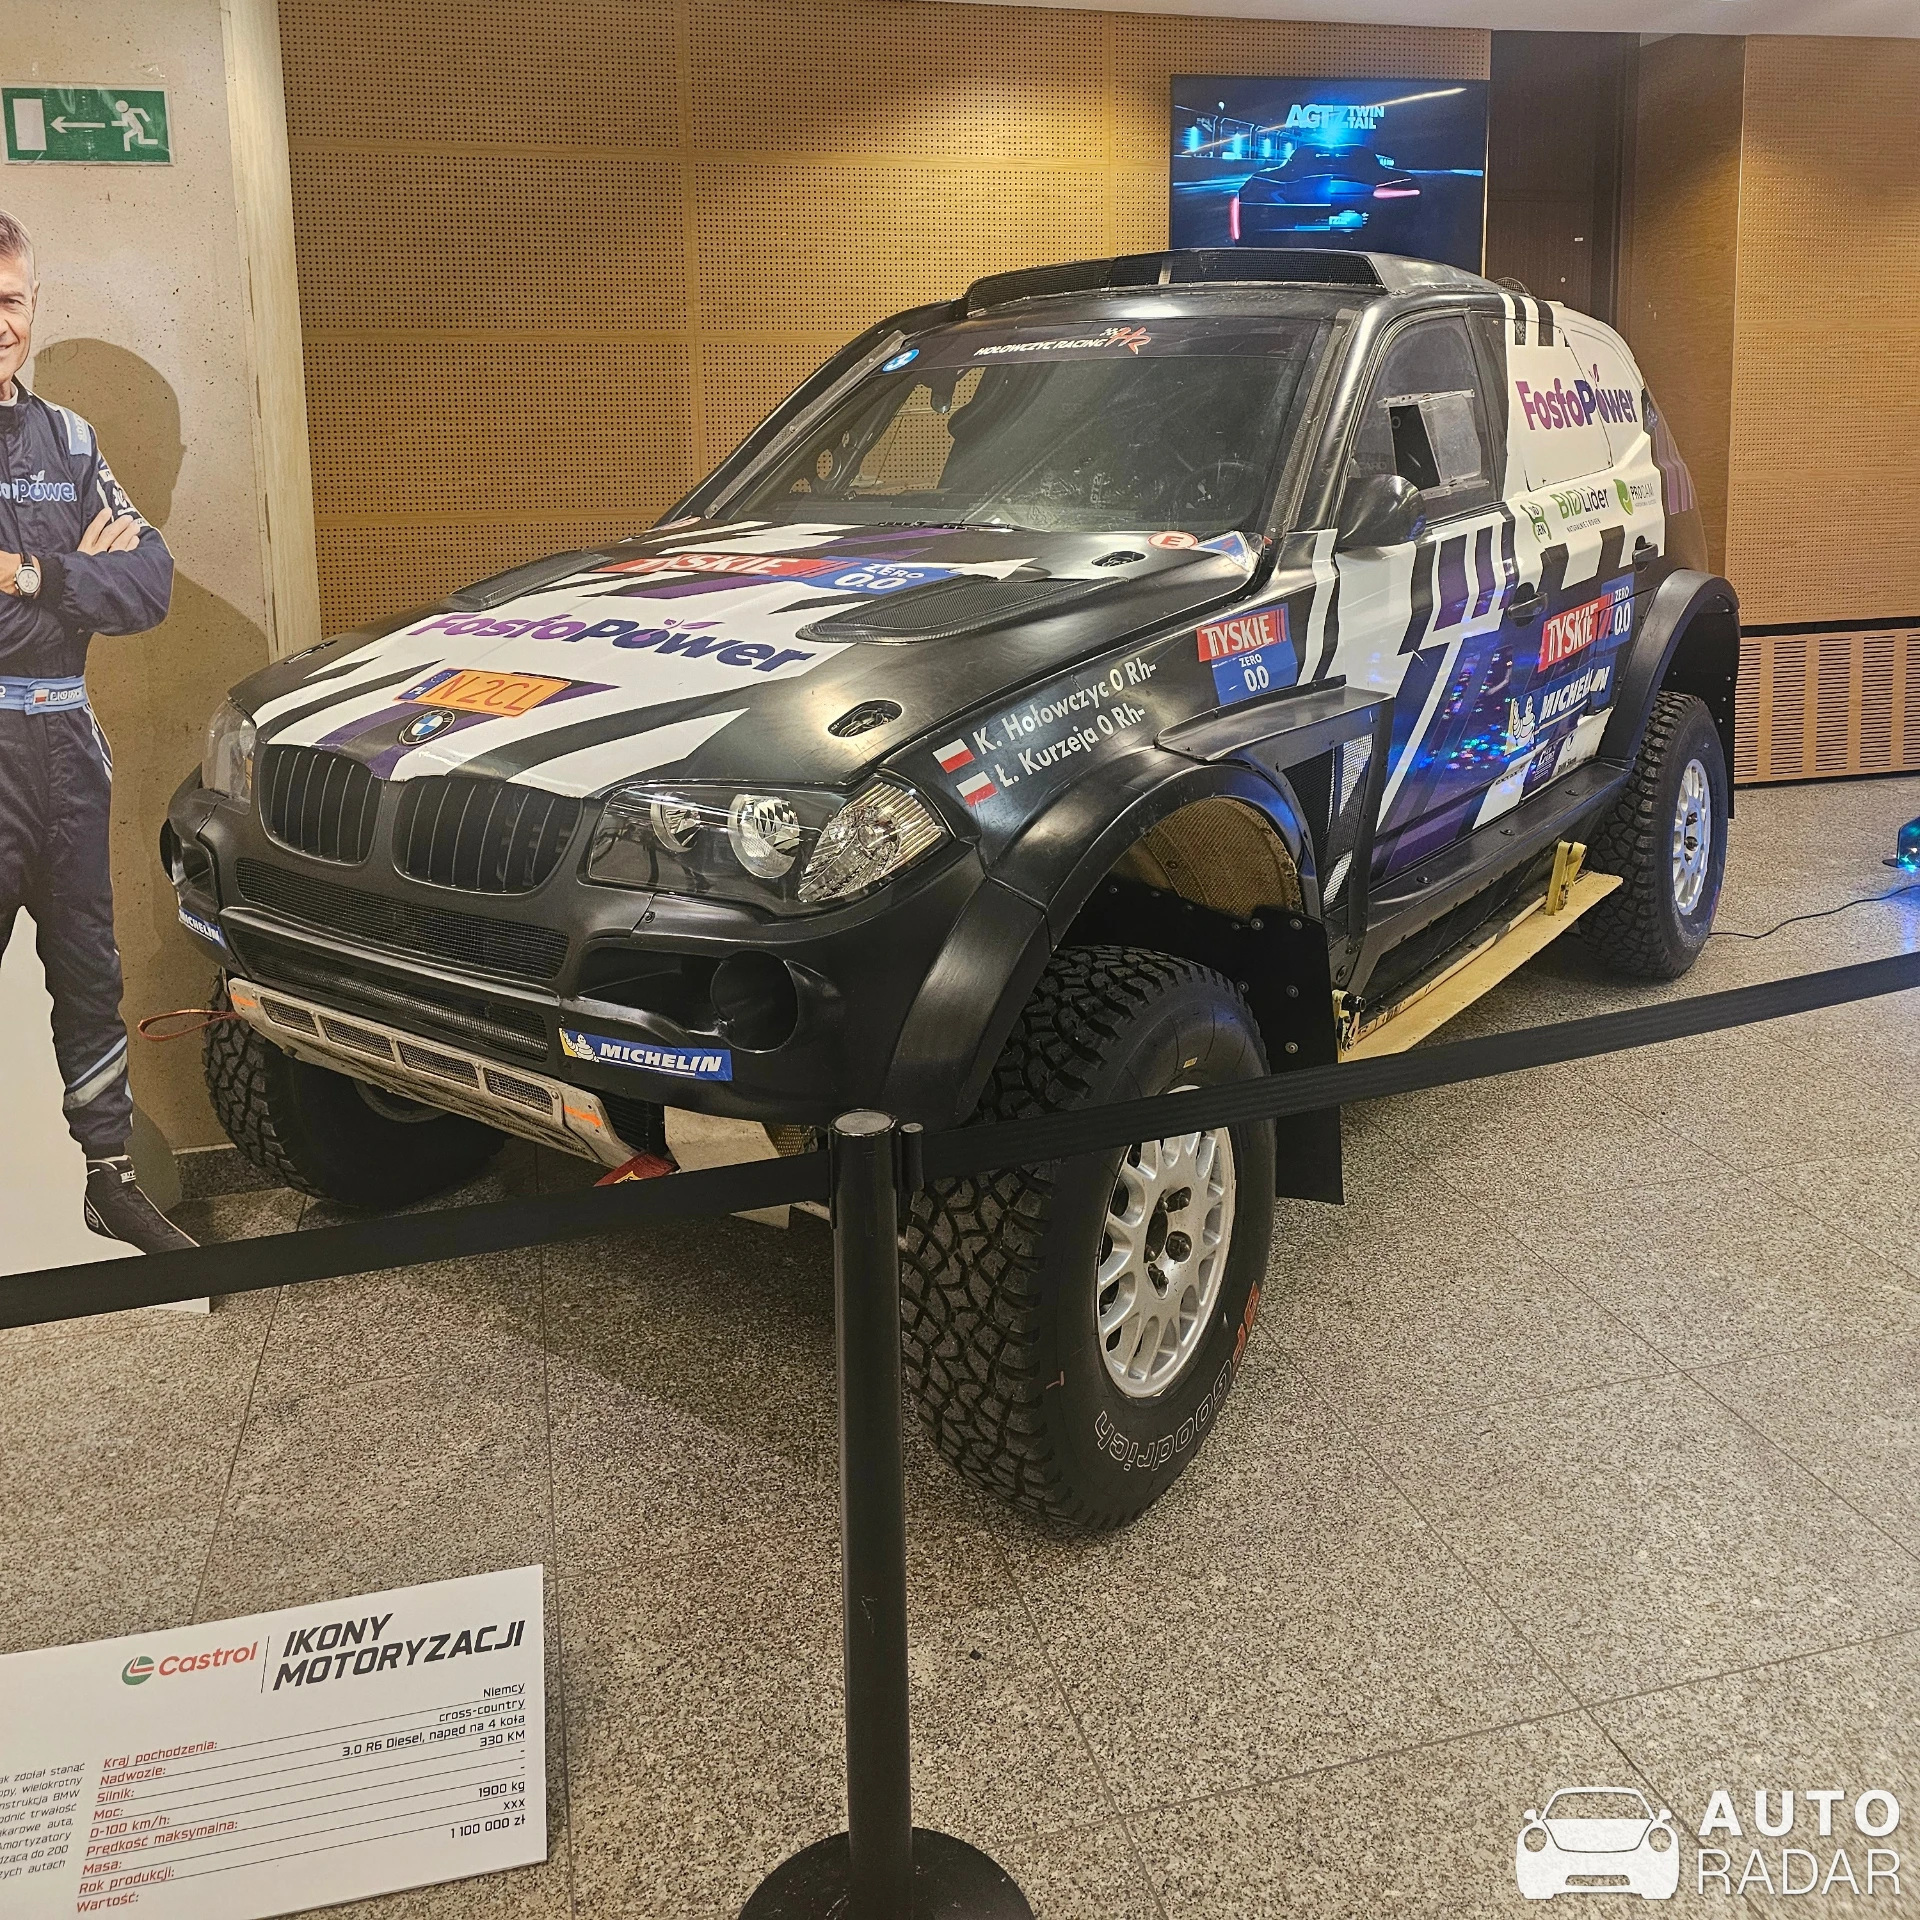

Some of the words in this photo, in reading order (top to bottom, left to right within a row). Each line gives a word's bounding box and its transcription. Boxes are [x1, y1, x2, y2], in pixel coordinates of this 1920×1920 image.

[1347, 106, 1385, 118] TWIN
[1347, 116, 1377, 129] TAIL
[1053, 338, 1109, 349] RACING
[1515, 378, 1638, 430] FosfoPower
[1161, 535, 1185, 547] E
[623, 553, 801, 574] TYSKIE
[861, 562, 925, 579] ZERO
[834, 572, 908, 591] 0.0
[1614, 586, 1630, 602] ZERO
[1614, 601, 1631, 636] 0.0
[1201, 614, 1274, 658] TYSKIE
[1546, 603, 1598, 663] TYSKIE
[406, 613, 817, 673] FosfoPower
[1238, 653, 1262, 668] ZERO
[1243, 665, 1270, 693] 0.0
[972, 726, 1003, 755] K.
[1001, 680, 1110, 742] Hołowczyc
[1124, 657, 1157, 686] Rh-
[994, 763, 1020, 788] Ł.
[1017, 725, 1100, 776] Kurzeja
[1110, 702, 1146, 730] Rh-
[599, 1042, 723, 1072] MICHELIN
[282, 1612, 394, 1657] IKONY
[159, 1641, 258, 1677] Castrol
[272, 1620, 526, 1691] MOTORYZACJI
[483, 1682, 525, 1698] Niemcy
[439, 1699, 526, 1722] cross-country
[342, 1744, 362, 1757] 3.0
[365, 1740, 382, 1753] R6
[386, 1732, 425, 1748] Diesel,
[429, 1723, 466, 1742] napęd
[469, 1722, 484, 1733] na
[487, 1718, 496, 1729] 4
[499, 1714, 525, 1726] koła
[479, 1734, 503, 1747] 330
[507, 1729, 526, 1742] KM
[103, 1755, 130, 1770] Kraj
[135, 1740, 218, 1767] pochodzenia:
[50, 1762, 86, 1777] stanąć
[100, 1766, 167, 1786] Nadwozie:
[22, 1776, 84, 1794] wielokrotny
[478, 1783, 507, 1797] 1900
[511, 1781, 526, 1793] kg
[52, 1788, 81, 1802] BMW
[97, 1788, 135, 1803] Silnik:
[503, 1798, 526, 1811] xxx
[30, 1803, 78, 1819] trwałość
[93, 1807, 124, 1821] Moc:
[47, 1818, 74, 1829] auta,
[89, 1822, 128, 1839] 0-100
[131, 1815, 171, 1831] km/h:
[450, 1828, 456, 1839] 1
[459, 1823, 480, 1837] 100
[484, 1818, 510, 1832] 000
[514, 1814, 526, 1826] zł
[86, 1836, 149, 1857] Prędkość
[153, 1820, 239, 1845] maksymalna:
[31, 1849, 45, 1860] do
[47, 1844, 69, 1857] 200
[27, 1859, 66, 1874] autach
[82, 1860, 123, 1876] Masa:
[78, 1879, 104, 1895] Rok
[108, 1866, 175, 1892] produkcji:
[76, 1891, 140, 1913] Wartość:
